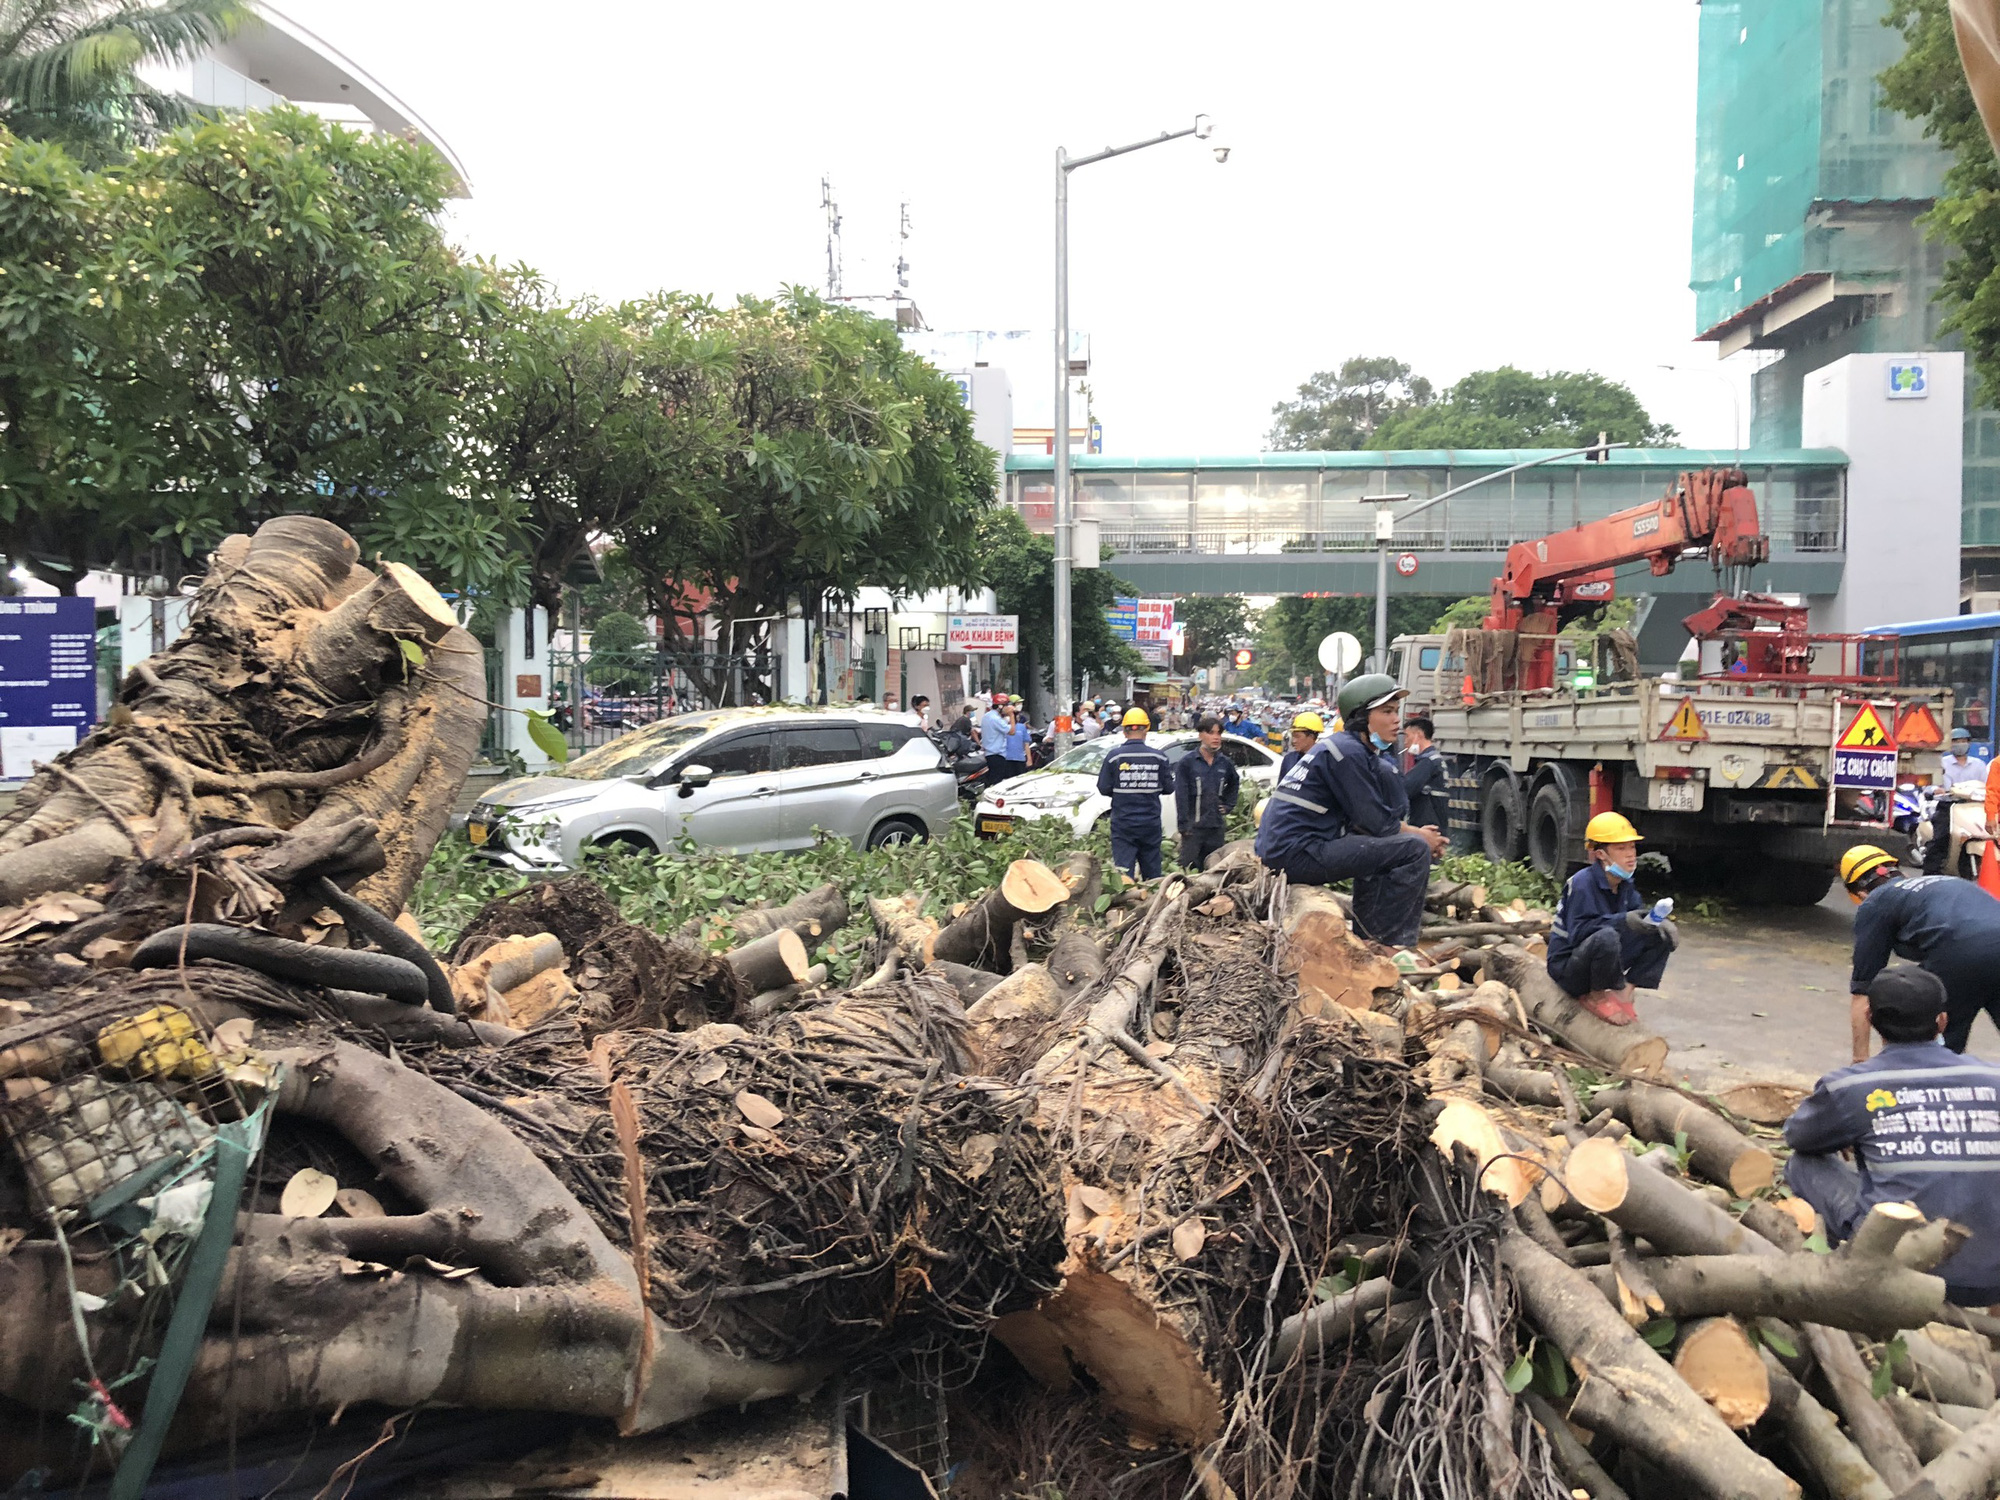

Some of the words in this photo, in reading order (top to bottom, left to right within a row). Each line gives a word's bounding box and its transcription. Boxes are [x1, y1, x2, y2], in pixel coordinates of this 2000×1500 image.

[950, 630, 970, 642] KHOA
[972, 627, 993, 642] KHÁM
[994, 628, 1014, 645] BỆNH
[1835, 757, 1847, 775] XE
[1847, 758, 1869, 779] CHẠY
[1667, 785, 1686, 796] 51E
[1895, 1086, 1926, 1105] CÔNG
[1925, 1088, 1940, 1102] TY
[1905, 1104, 1941, 1133] VIÊN
[1939, 1103, 1967, 1133] CÂY
[1930, 1137, 1962, 1155] CHÍ
